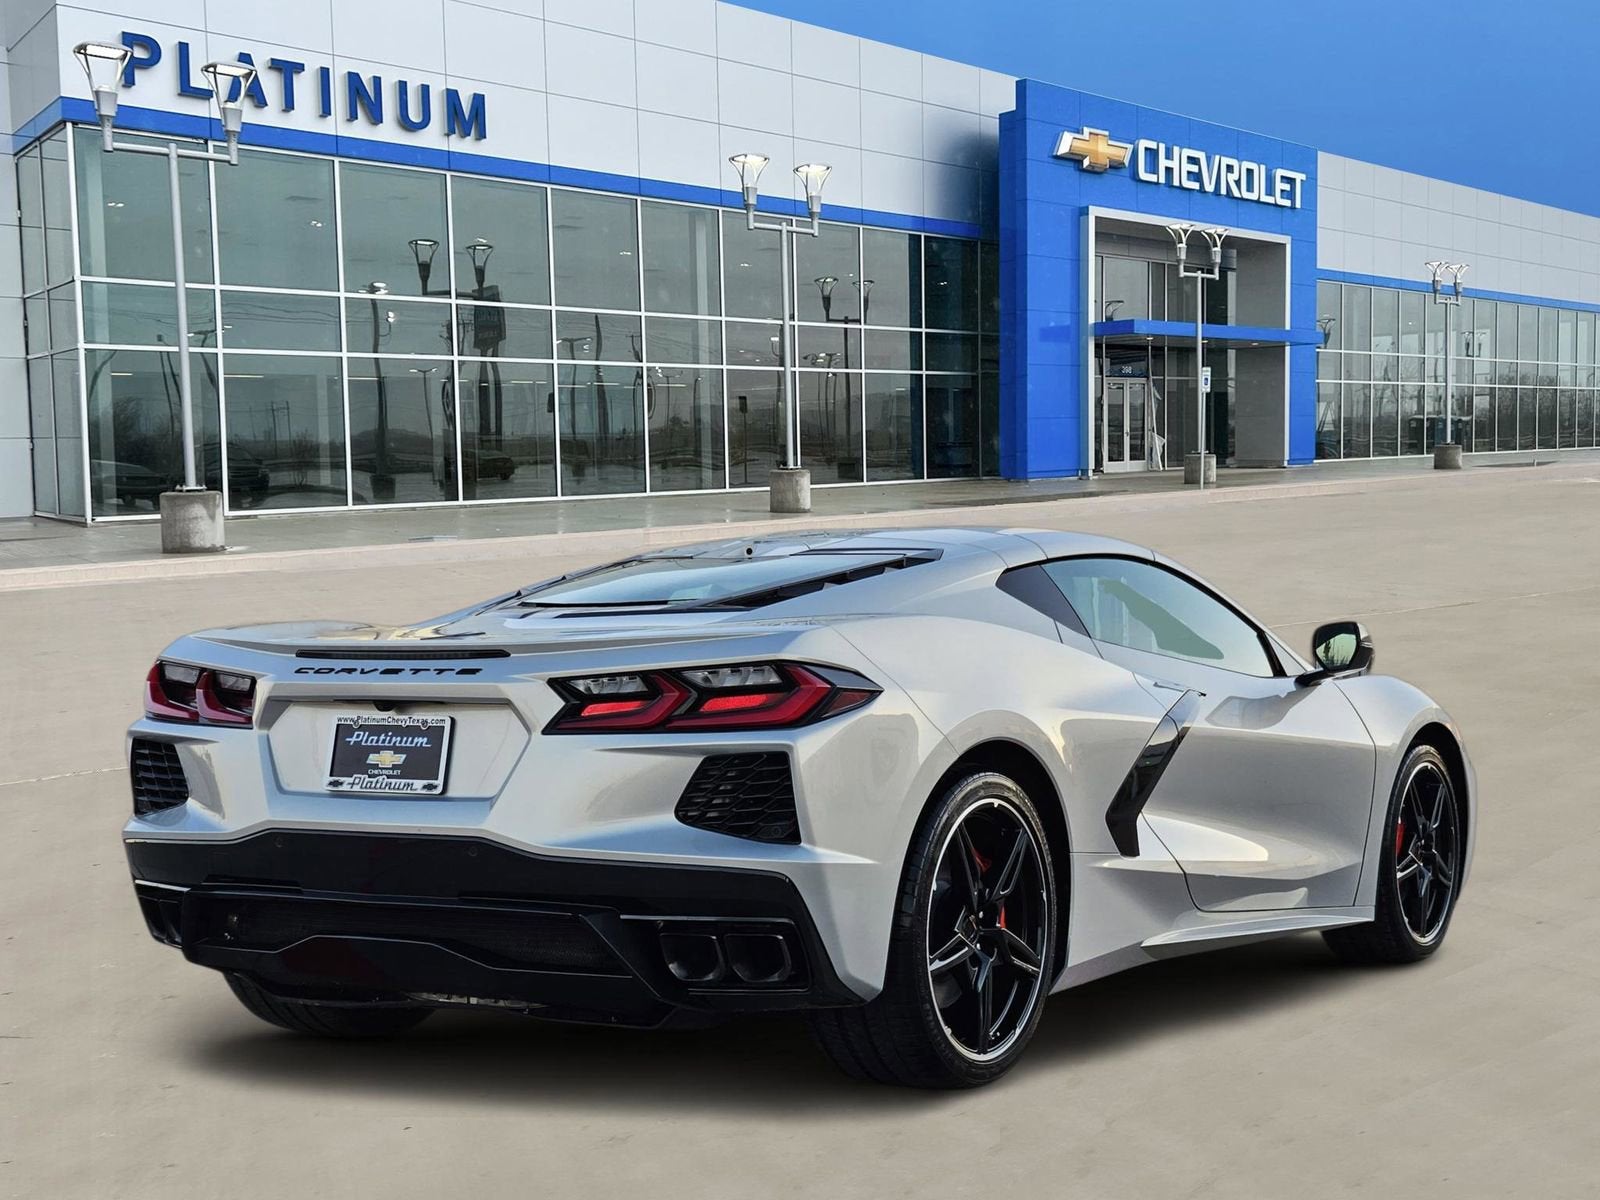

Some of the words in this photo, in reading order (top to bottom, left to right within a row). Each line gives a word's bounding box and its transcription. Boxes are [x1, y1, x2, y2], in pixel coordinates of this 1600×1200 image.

[121, 31, 488, 141] PLATINUM
[1136, 138, 1307, 209] CHEVROLET
[294, 667, 483, 676] CORVETTE
[336, 715, 446, 727] www.PlatinumChevyTexas.com
[345, 731, 432, 748] Platinum
[367, 768, 402, 776] CHEVROLET
[346, 776, 418, 792] Platinum
